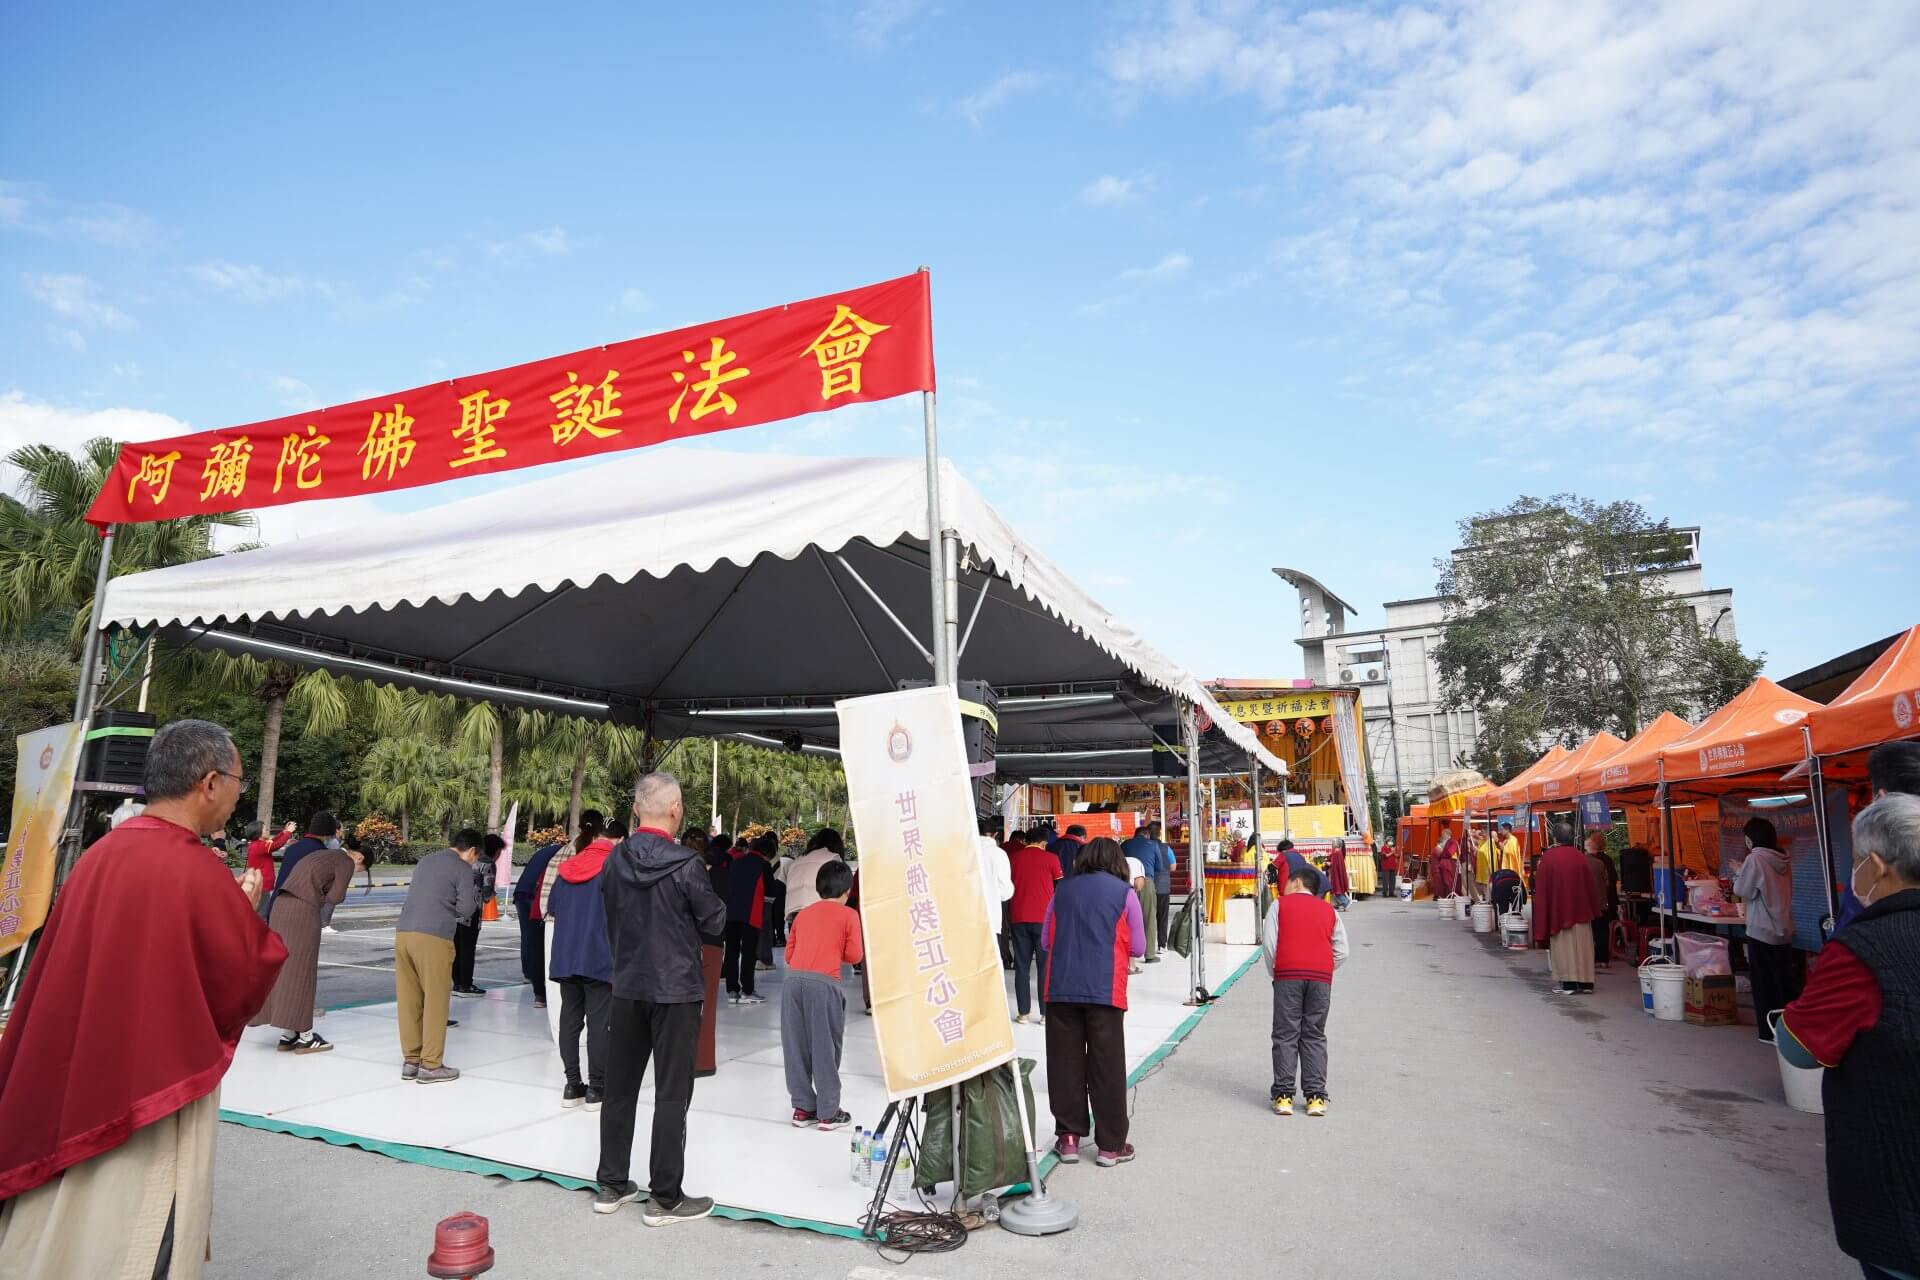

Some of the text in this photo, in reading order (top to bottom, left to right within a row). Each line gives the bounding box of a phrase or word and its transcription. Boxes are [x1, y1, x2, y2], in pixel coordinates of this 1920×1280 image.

[127, 303, 893, 505] 阿彌陀佛聖誕法會
